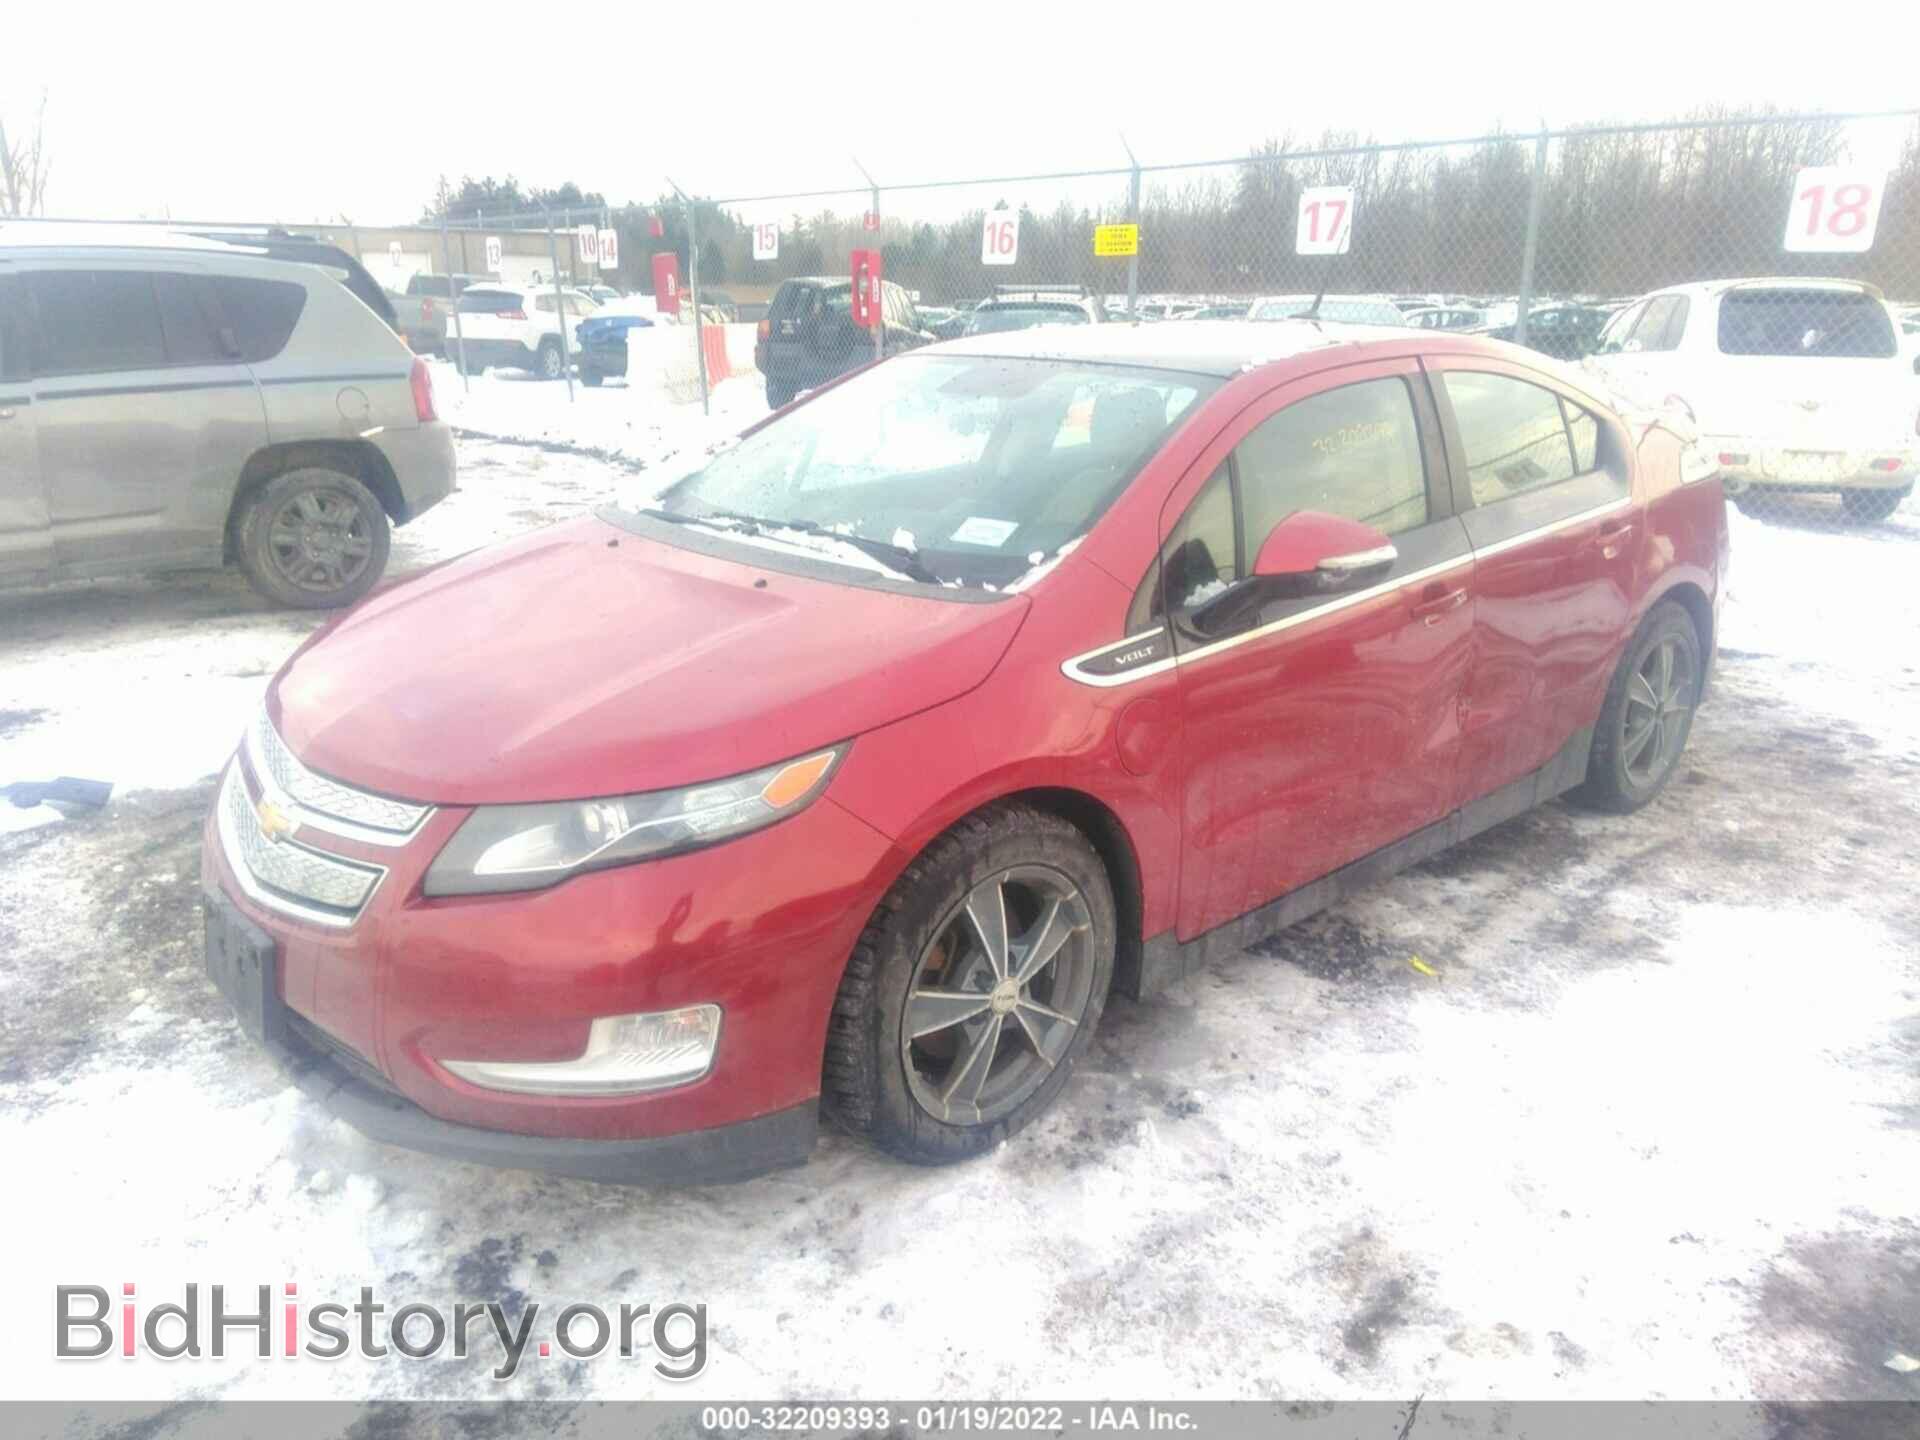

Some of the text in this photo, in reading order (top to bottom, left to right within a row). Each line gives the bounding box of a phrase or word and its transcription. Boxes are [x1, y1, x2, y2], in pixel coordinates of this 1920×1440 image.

[1304, 200, 1346, 241] 17
[1800, 184, 1873, 236] 18
[581, 233, 596, 256] 10
[600, 237, 616, 262] 14
[757, 223, 775, 250] 15
[986, 221, 1014, 254] 16
[1115, 645, 1154, 665] VOLT
